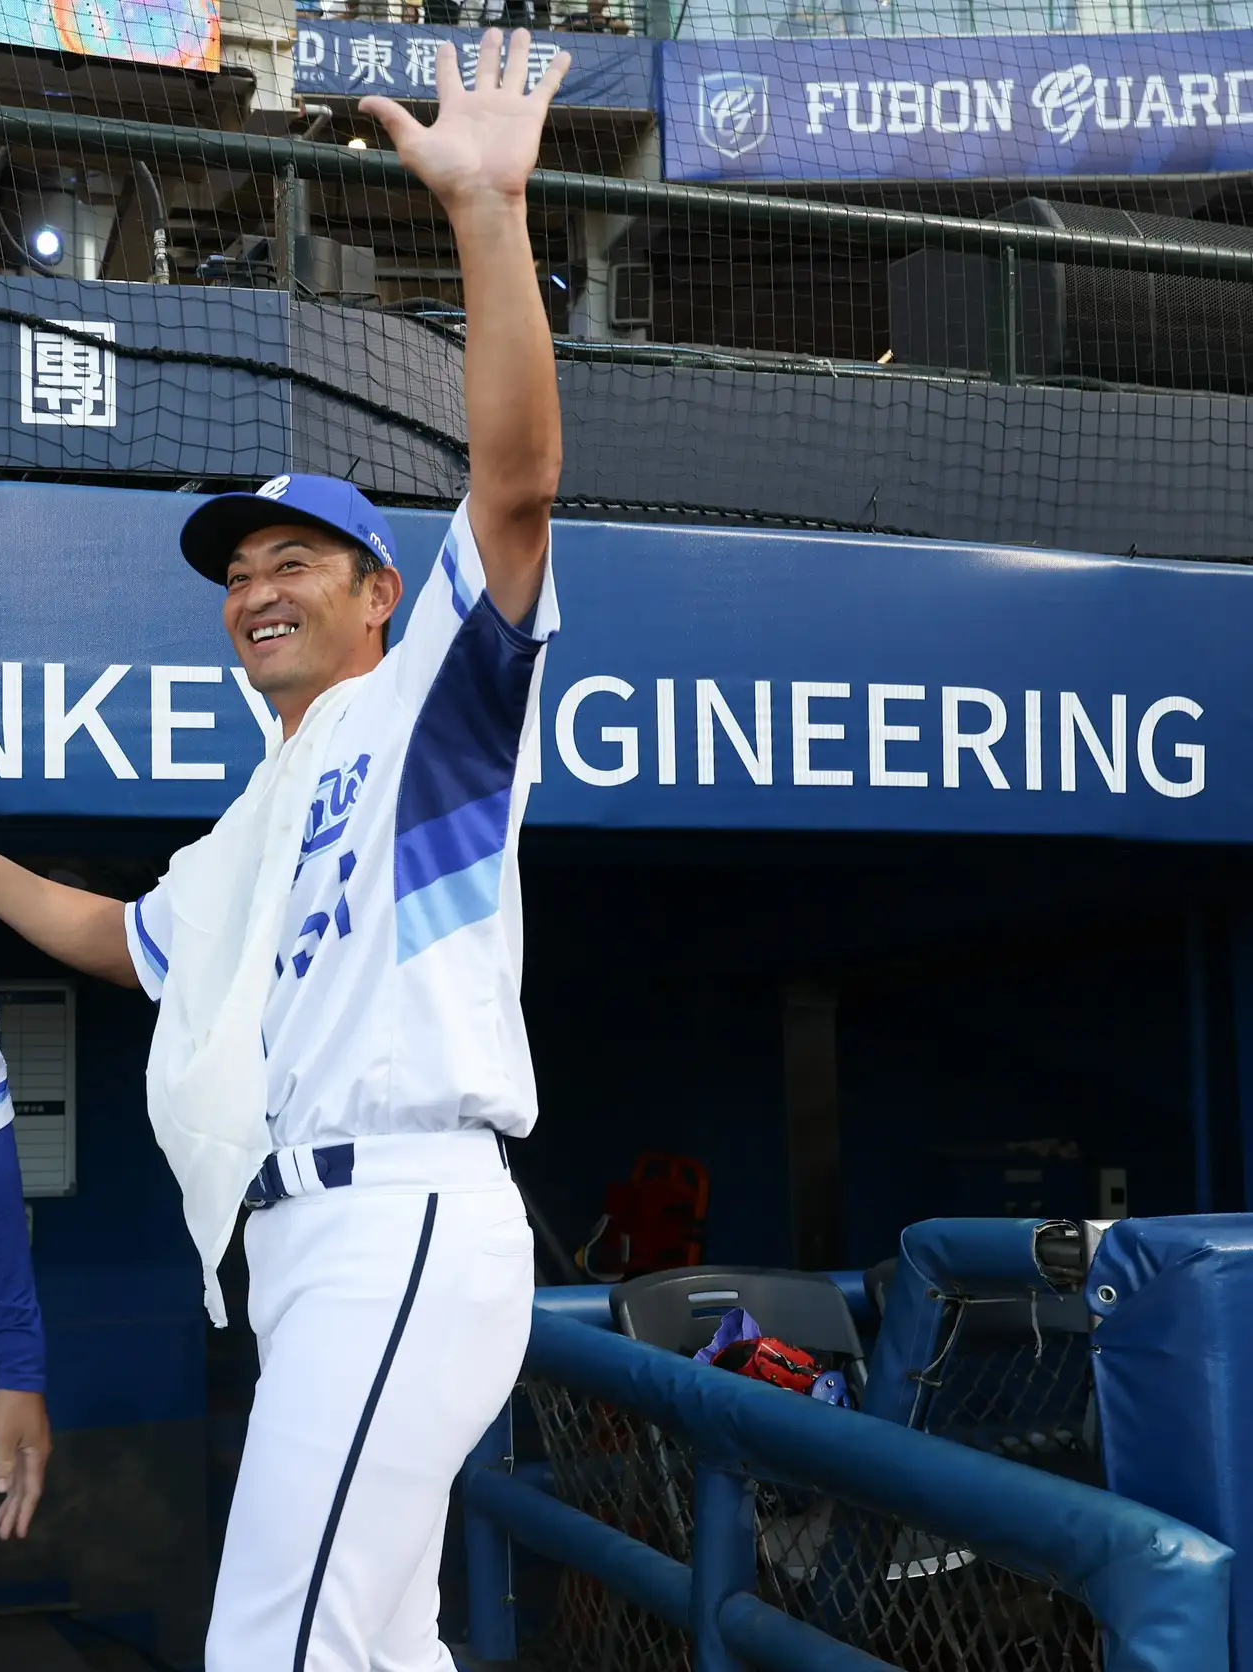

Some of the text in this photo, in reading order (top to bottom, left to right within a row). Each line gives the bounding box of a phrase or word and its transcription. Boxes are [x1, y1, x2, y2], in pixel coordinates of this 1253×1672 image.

[294, 30, 325, 66] D
[806, 79, 1015, 135] FUBON
[528, 675, 1205, 798] GINEERING
